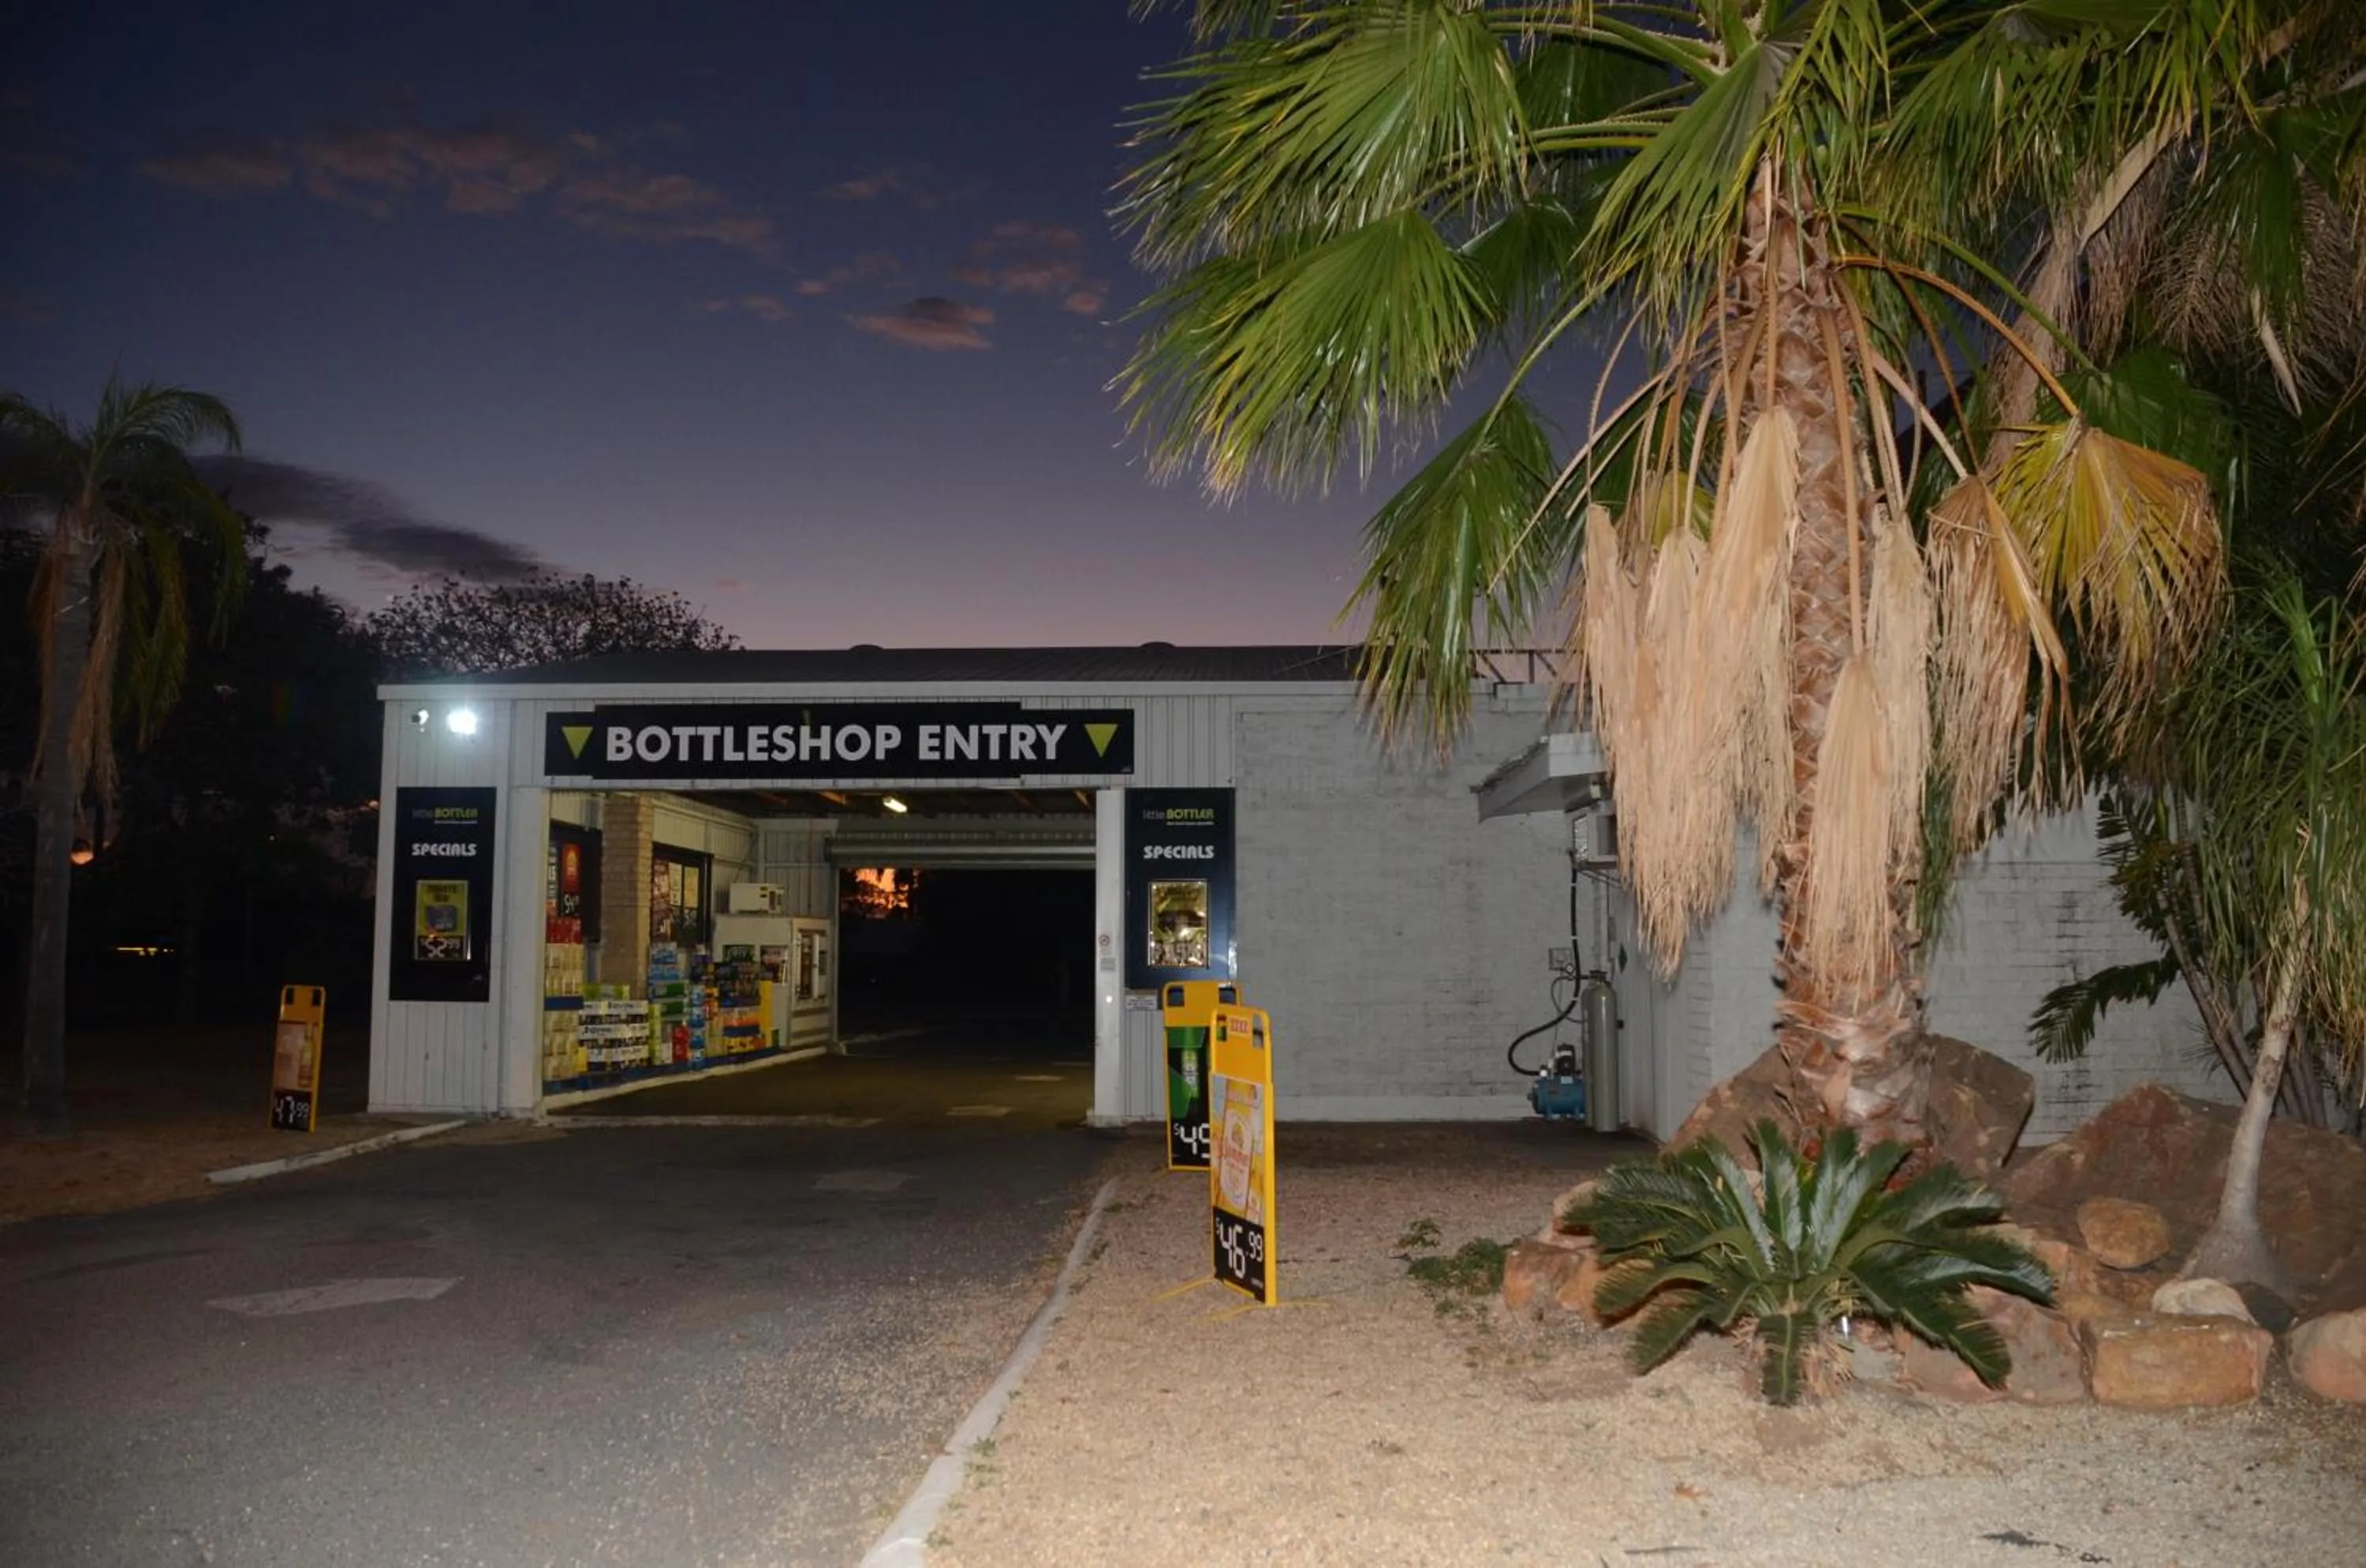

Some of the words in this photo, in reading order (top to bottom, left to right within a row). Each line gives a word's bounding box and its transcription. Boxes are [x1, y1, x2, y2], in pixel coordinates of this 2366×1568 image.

[606, 724, 902, 762] BOTTLESHOP
[918, 723, 1068, 760] ENTRY
[1166, 808, 1215, 820] BOTTLER
[411, 842, 477, 857] SPECIALS
[1143, 845, 1215, 860] SPECIALS
